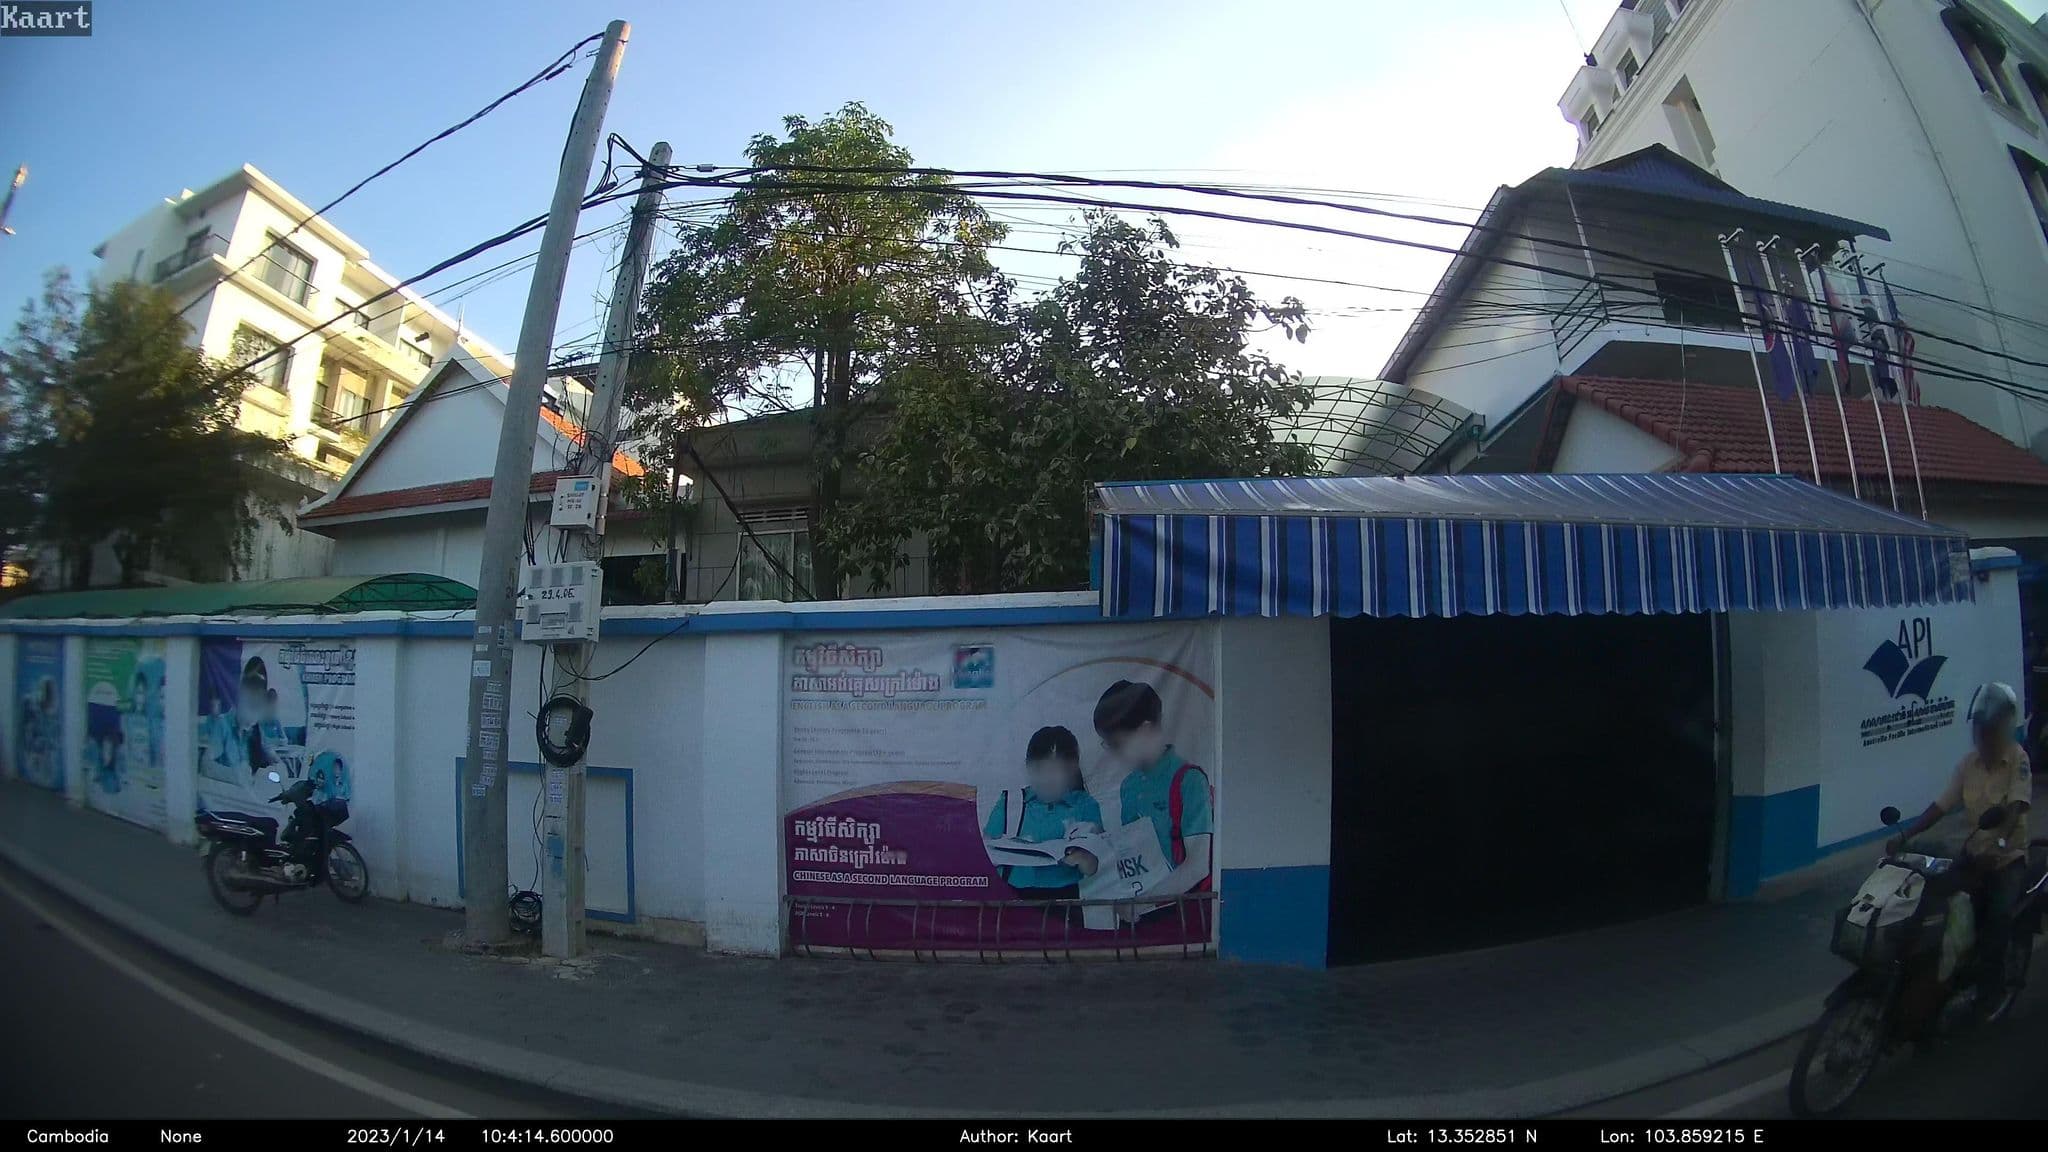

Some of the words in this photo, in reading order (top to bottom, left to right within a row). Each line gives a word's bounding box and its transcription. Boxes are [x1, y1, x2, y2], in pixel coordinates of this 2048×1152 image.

[1898, 617, 1932, 659] API
[794, 816, 881, 845] កម្មវិធីសិក្សា
[793, 871, 831, 883] CHINESE
[831, 872, 844, 883] AS
[844, 873, 852, 884] A
[852, 874, 888, 885] SECOND
[889, 874, 939, 886] LANGUAGE
[940, 876, 988, 887] PROGRAM
[1116, 854, 1149, 880] HSK
